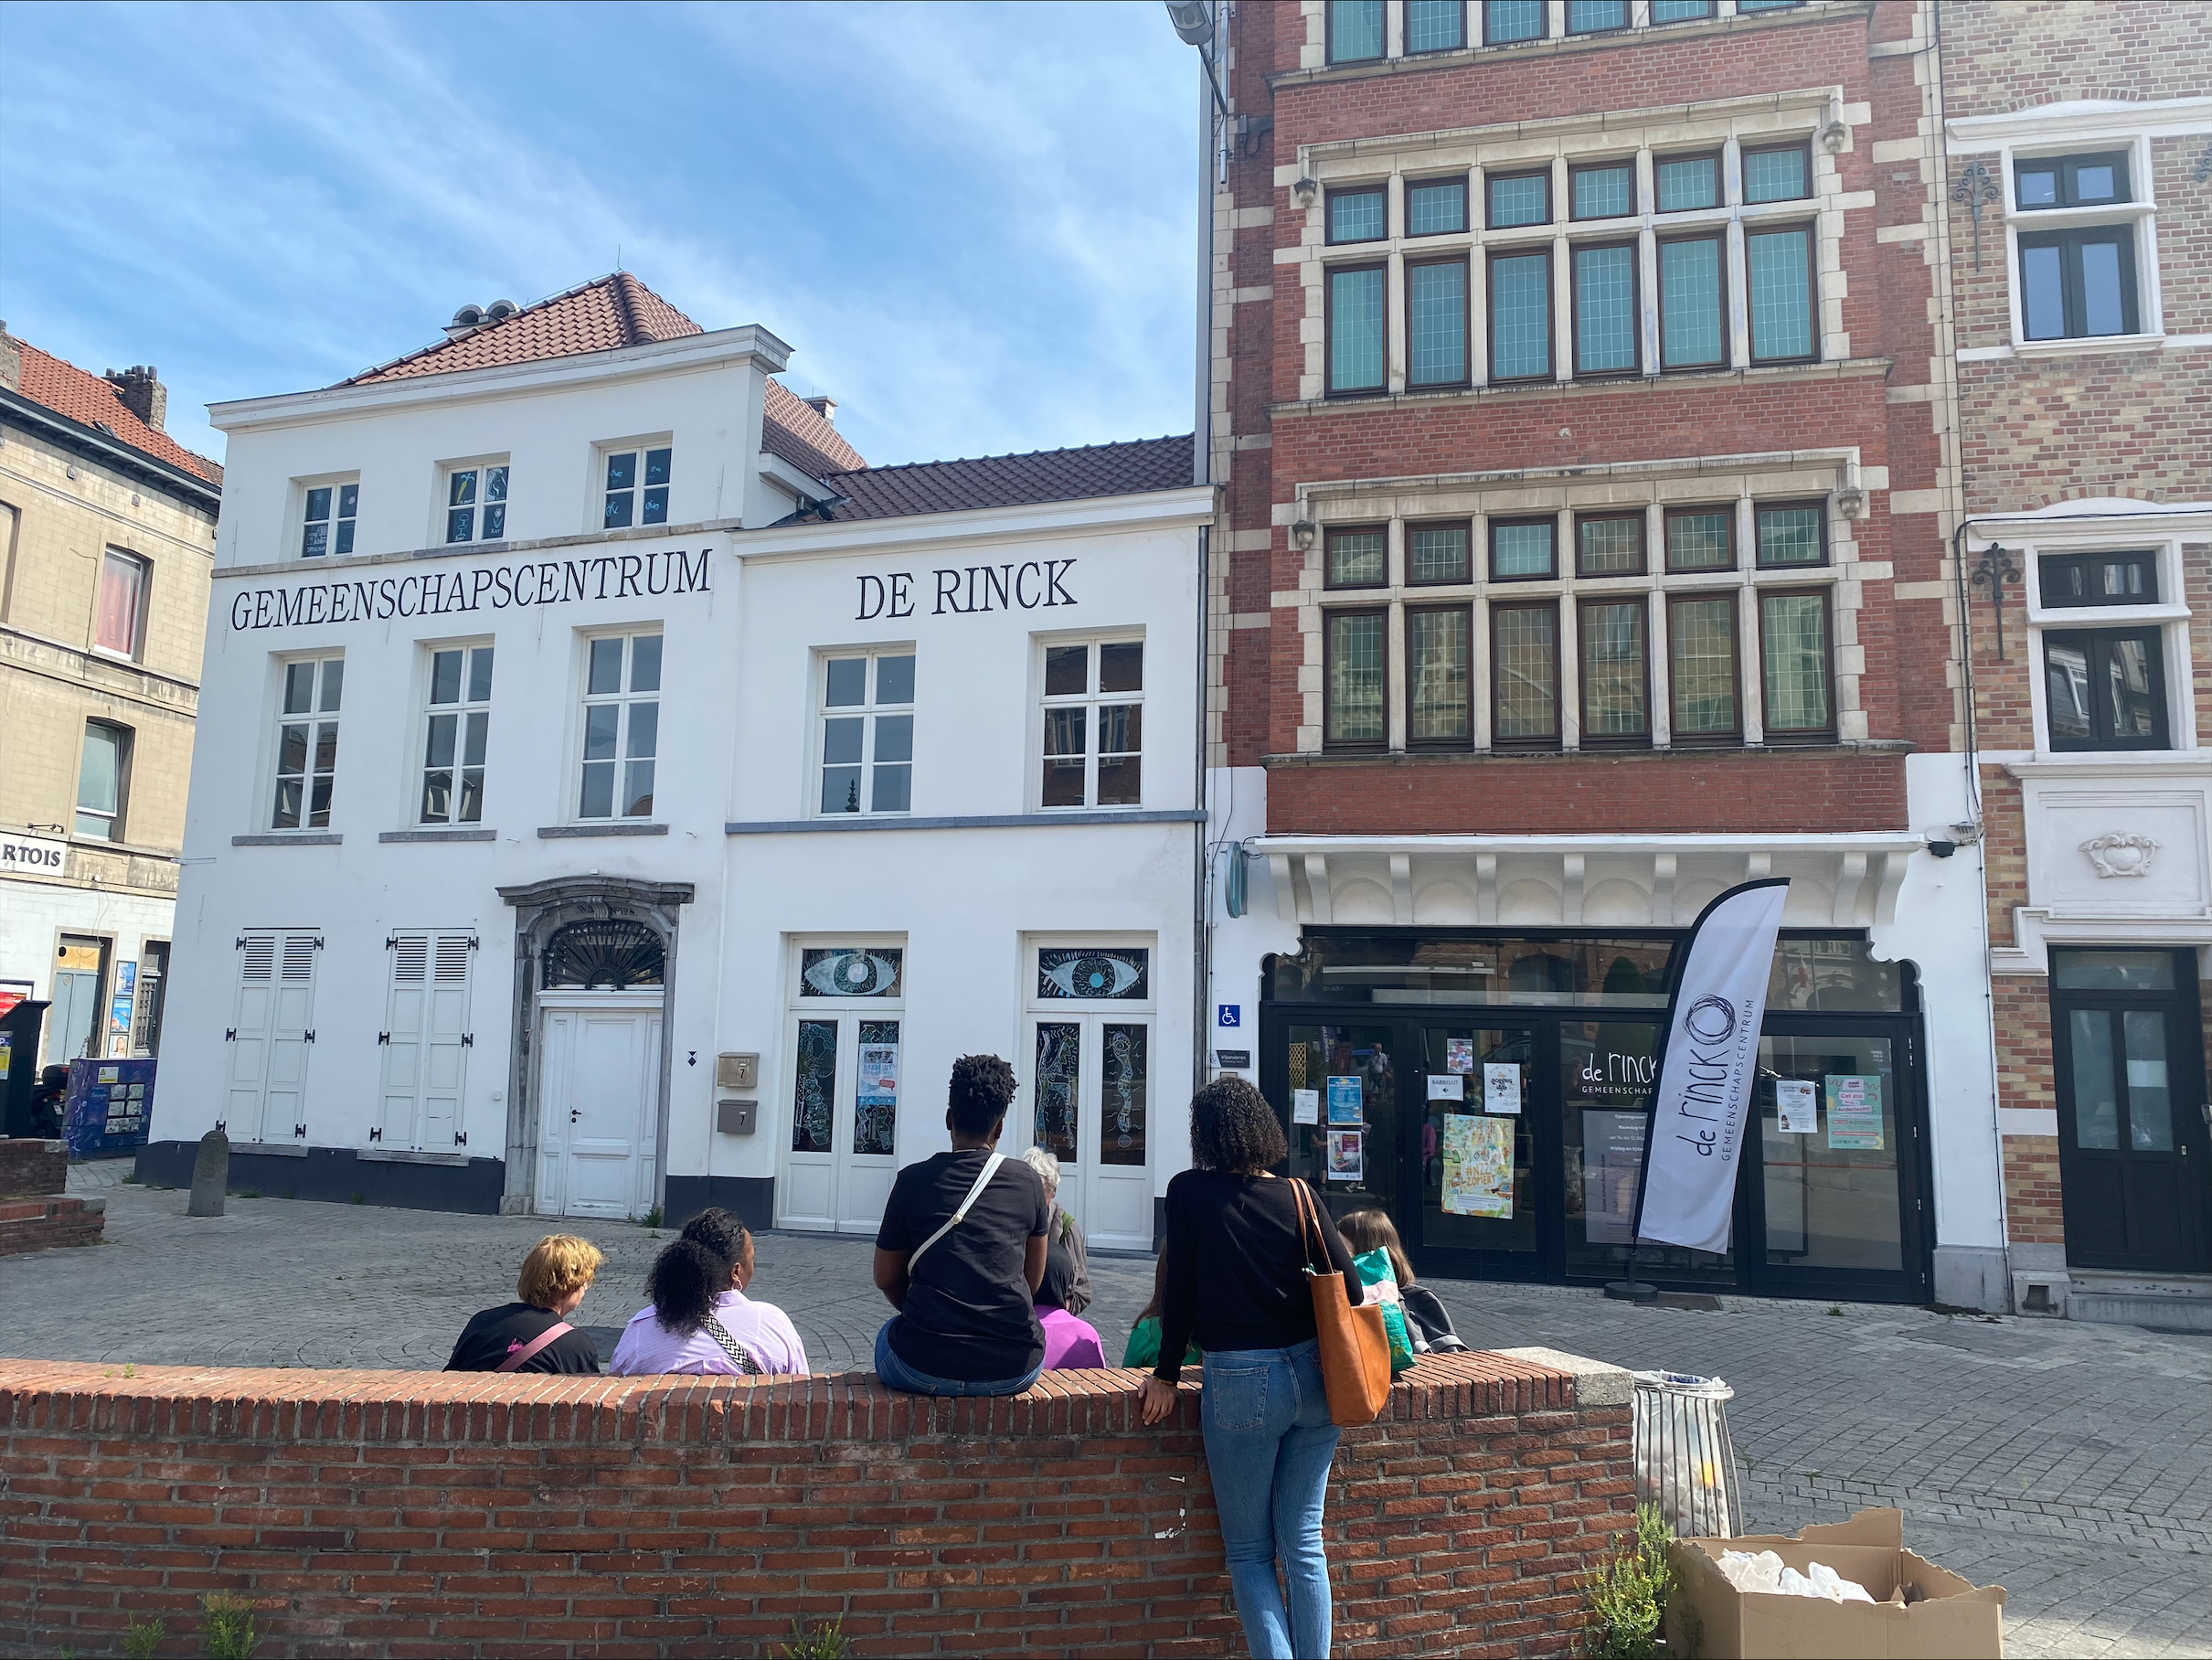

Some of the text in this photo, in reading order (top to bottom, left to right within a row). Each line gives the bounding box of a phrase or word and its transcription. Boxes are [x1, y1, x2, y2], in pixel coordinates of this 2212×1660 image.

[231, 548, 713, 631] GEMEENSCHAPSCENTRUM
[855, 559, 1078, 621] DE RINCK
[1, 844, 60, 867] RTOIS
[739, 1069, 745, 1079] 7
[1582, 1052, 1602, 1081] de
[1721, 999, 1755, 1161] GEMEENSCHAPSCENTRUM
[740, 1115, 745, 1125] 7
[1676, 1130, 1717, 1156] de
[1466, 1175, 1496, 1186] ZOMERT
